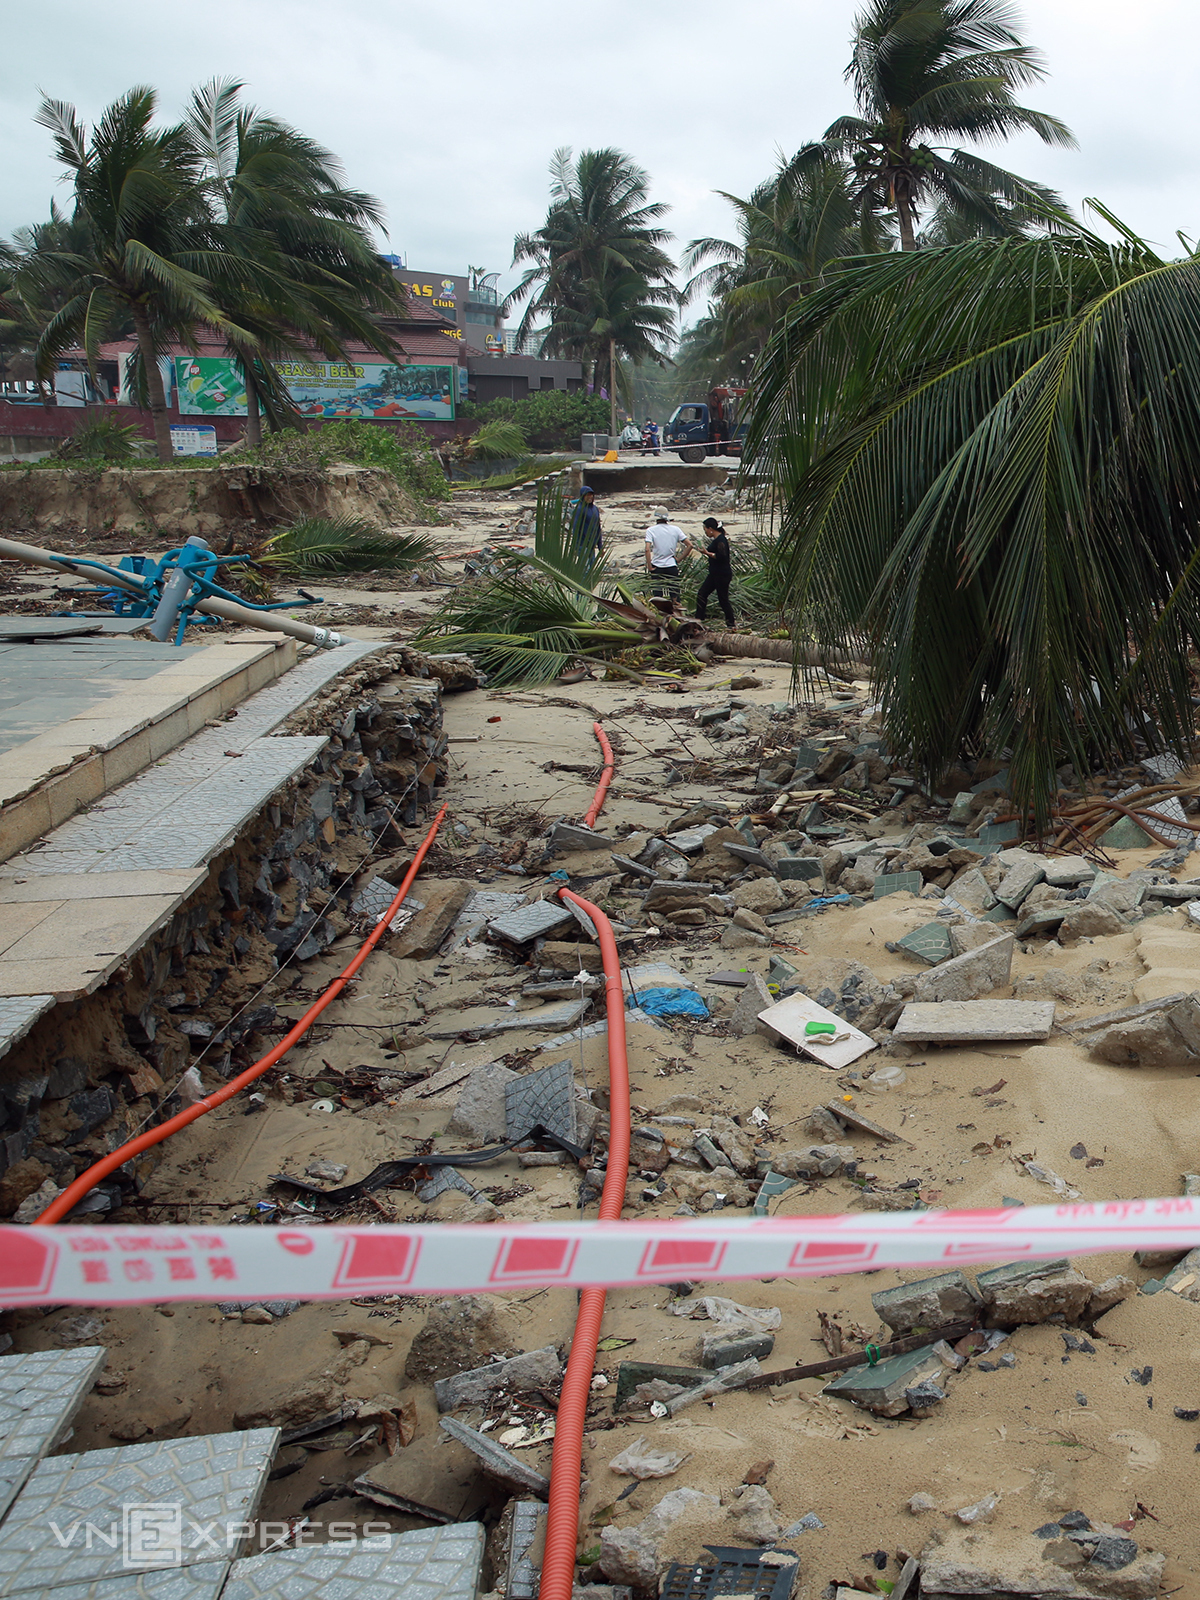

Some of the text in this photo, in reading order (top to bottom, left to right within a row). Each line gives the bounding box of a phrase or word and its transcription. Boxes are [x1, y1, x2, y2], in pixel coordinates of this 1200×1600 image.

[432, 298, 455, 308] Club
[274, 364, 365, 378] BEACH BEER
